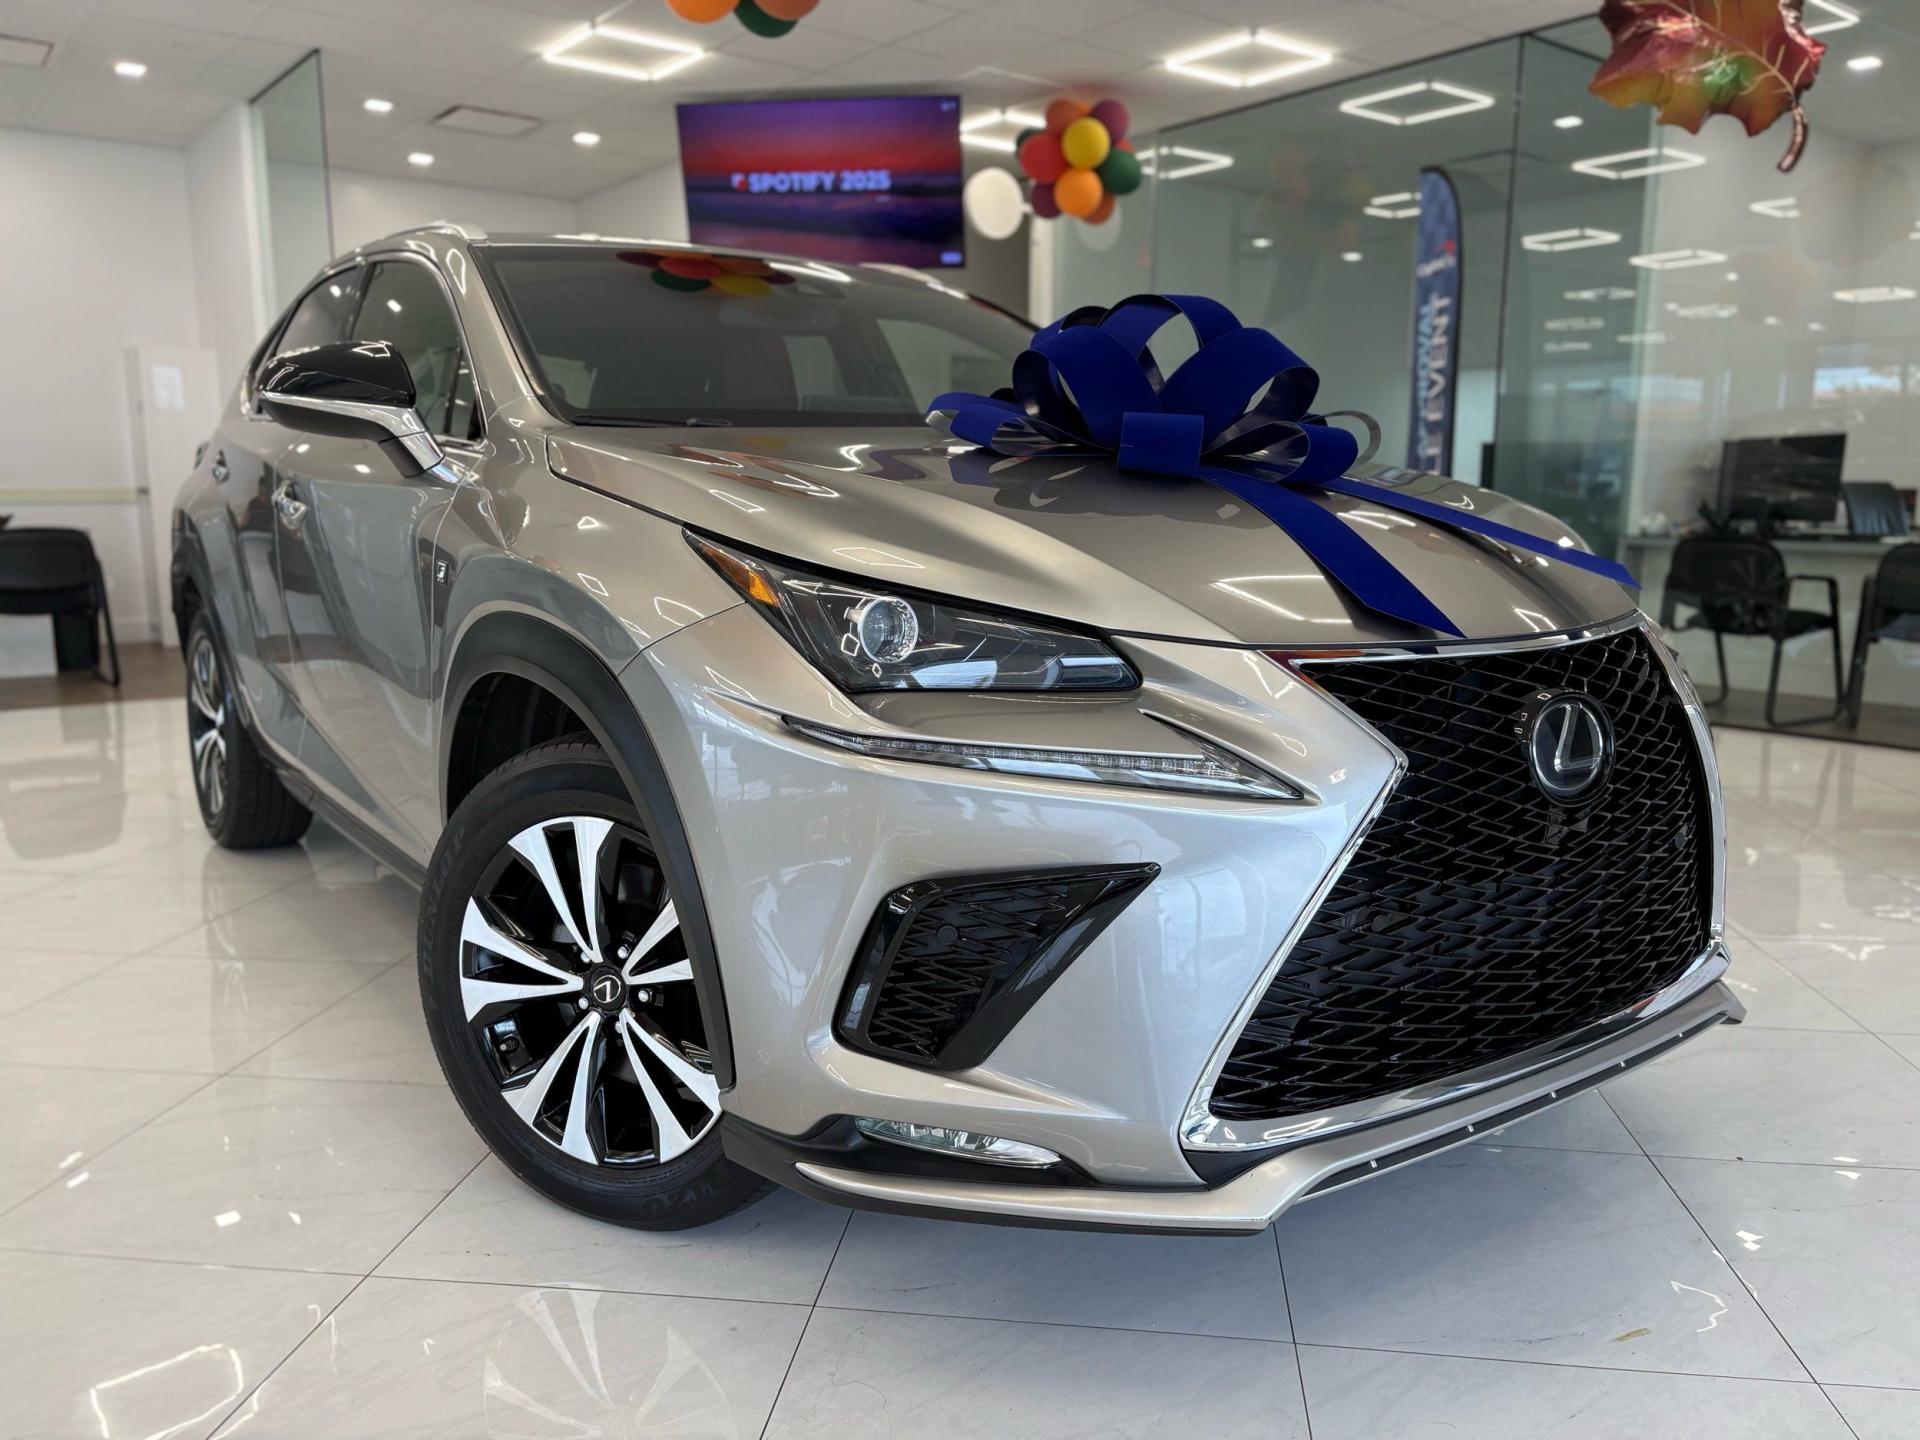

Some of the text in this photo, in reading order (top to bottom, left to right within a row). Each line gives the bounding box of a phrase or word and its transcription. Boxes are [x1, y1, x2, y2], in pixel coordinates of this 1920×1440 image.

[749, 169, 892, 193] SPOTIFY 2025
[1426, 293, 1450, 422] EVENT
